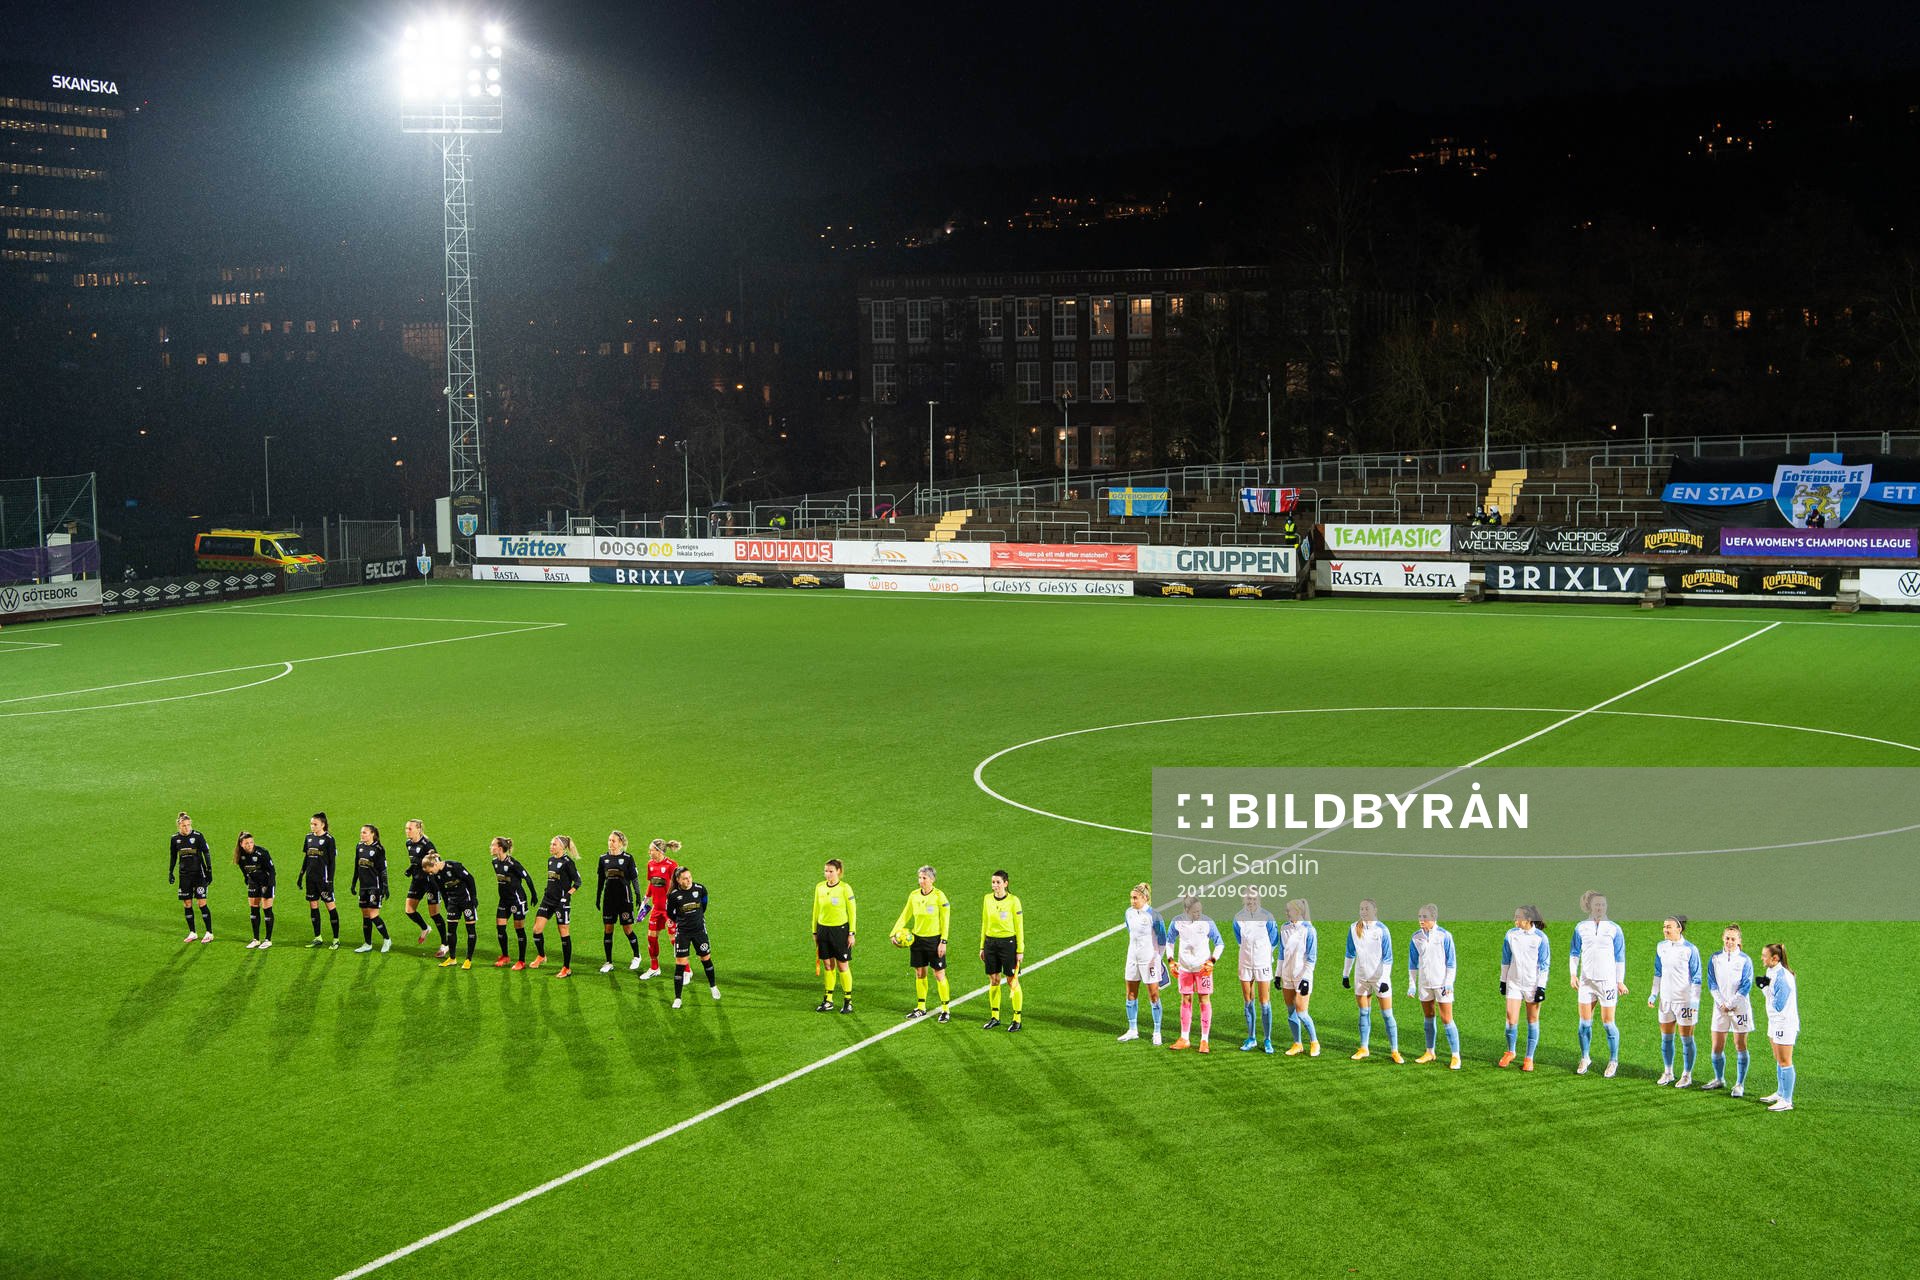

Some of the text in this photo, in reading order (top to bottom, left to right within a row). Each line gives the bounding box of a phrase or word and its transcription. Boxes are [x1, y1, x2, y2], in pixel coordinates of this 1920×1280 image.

[52, 75, 119, 95] SKANSKA
[1672, 486, 1764, 500] EN STAD
[1882, 486, 1916, 499] ETT
[1334, 527, 1442, 548] TEAMTASTIC
[1470, 530, 1518, 541] NORDIC
[1557, 531, 1607, 542] NORDIC
[1644, 532, 1703, 550] KOPPARBERG
[1725, 537, 1912, 548] UEFA WOMEN'S CHAMPIONS LEAGUE
[498, 537, 567, 556] Tvättex
[735, 541, 833, 562] BAUHAUS
[1459, 540, 1529, 551] WELLNESS
[1546, 542, 1619, 552] WELLNESS
[1176, 549, 1290, 574] GRUPPEN
[365, 560, 407, 580] SELECT
[494, 571, 520, 580] RASTA
[544, 573, 570, 581] RASTA
[615, 568, 685, 585] BRIXLY
[1332, 572, 1383, 586] RASTA
[1404, 573, 1456, 588] RASTA
[1498, 565, 1635, 591] BRIXLY
[1681, 572, 1738, 589] KOPPARBERG
[1762, 573, 1821, 590] KOPPARBERG
[868, 581, 898, 590] WIBO
[928, 583, 959, 592] WIBO
[992, 581, 1031, 592] GleSYS
[1085, 583, 1125, 594] GleSYS
[22, 587, 78, 602] GÖTEBORG
[1605, 989, 1616, 1001] 22
[1736, 1014, 1748, 1026] 24
